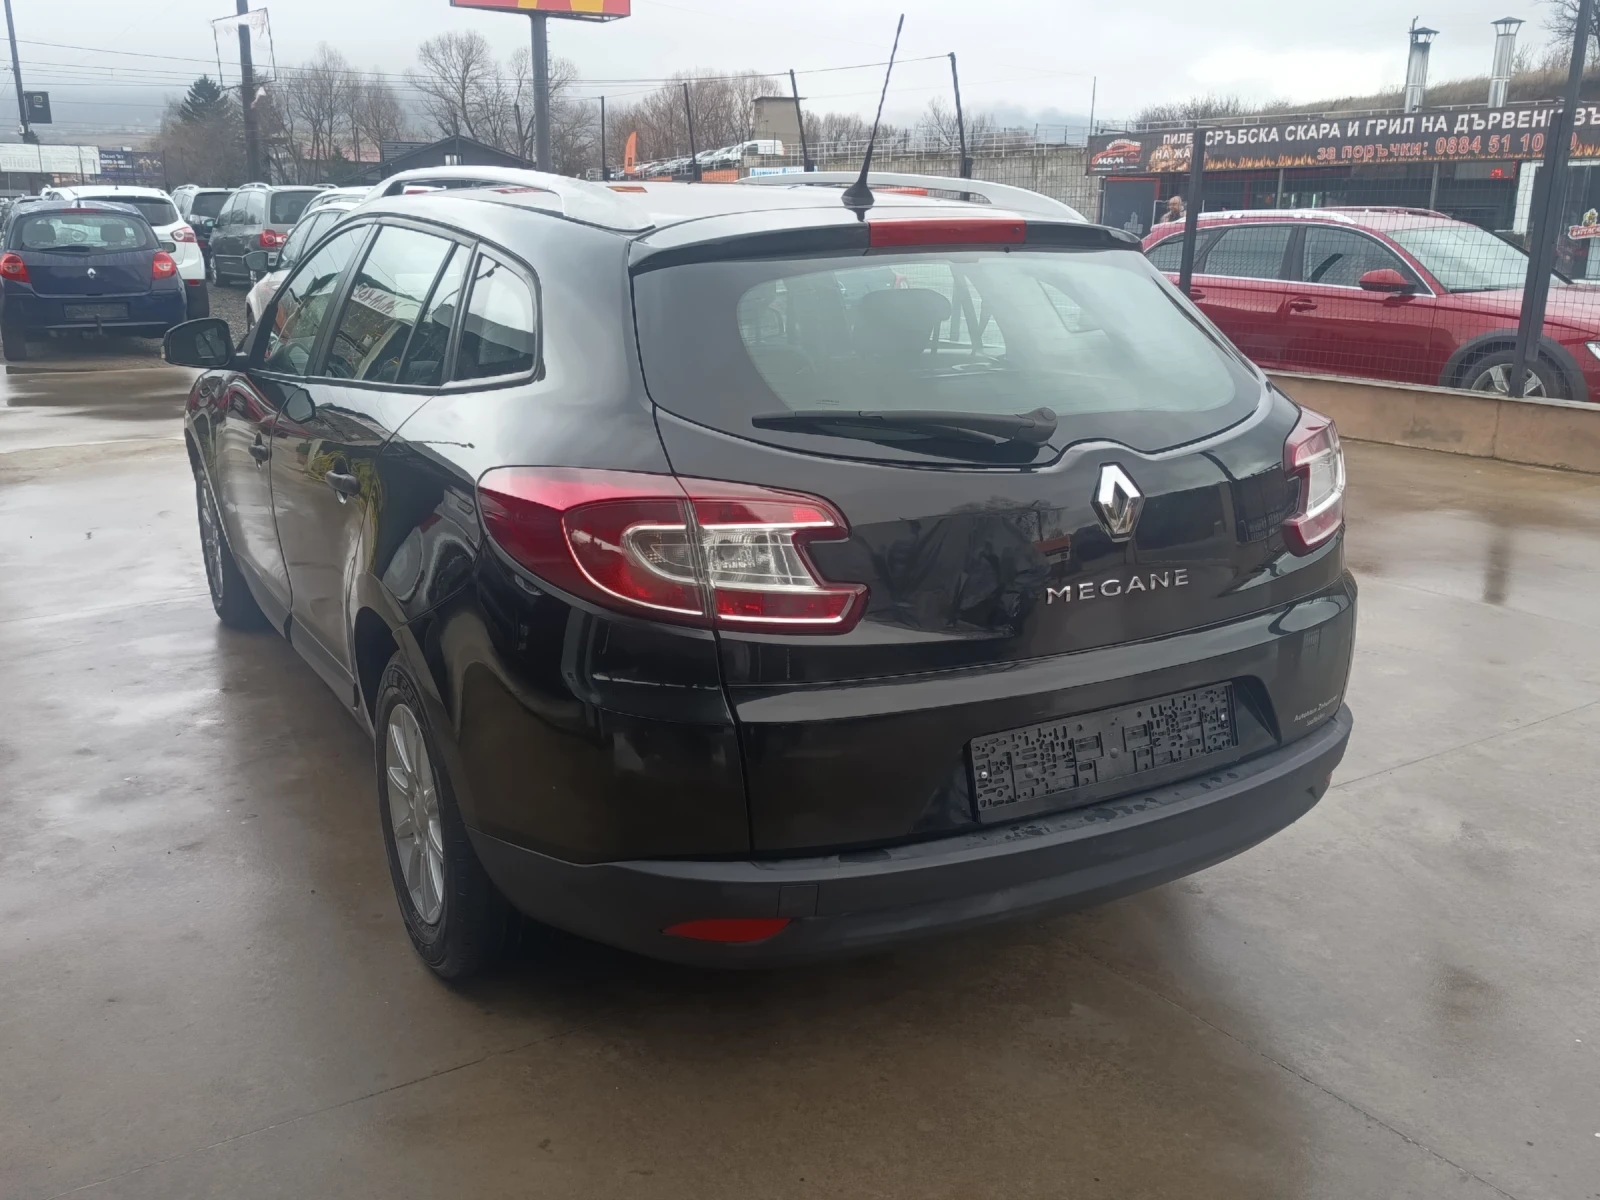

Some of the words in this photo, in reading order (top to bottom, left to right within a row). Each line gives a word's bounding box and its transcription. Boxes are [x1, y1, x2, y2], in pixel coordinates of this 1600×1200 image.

[1163, 132, 1193, 145] ПИЛЕ
[1205, 127, 1279, 146] СРЪБСКА
[1284, 122, 1341, 141] СКАРА
[1347, 121, 1360, 137] И
[1365, 117, 1415, 136] ГРИЛ
[1421, 115, 1448, 133] НА
[1454, 109, 1564, 134] ДЪРВЕН
[1155, 149, 1170, 160] НА
[1317, 146, 1336, 160] за
[1342, 142, 1429, 161] поръчки:
[1435, 136, 1481, 155] 0884
[1488, 134, 1510, 153] 51
[1520, 132, 1544, 152] 10
[1046, 568, 1190, 605] MEGANE
